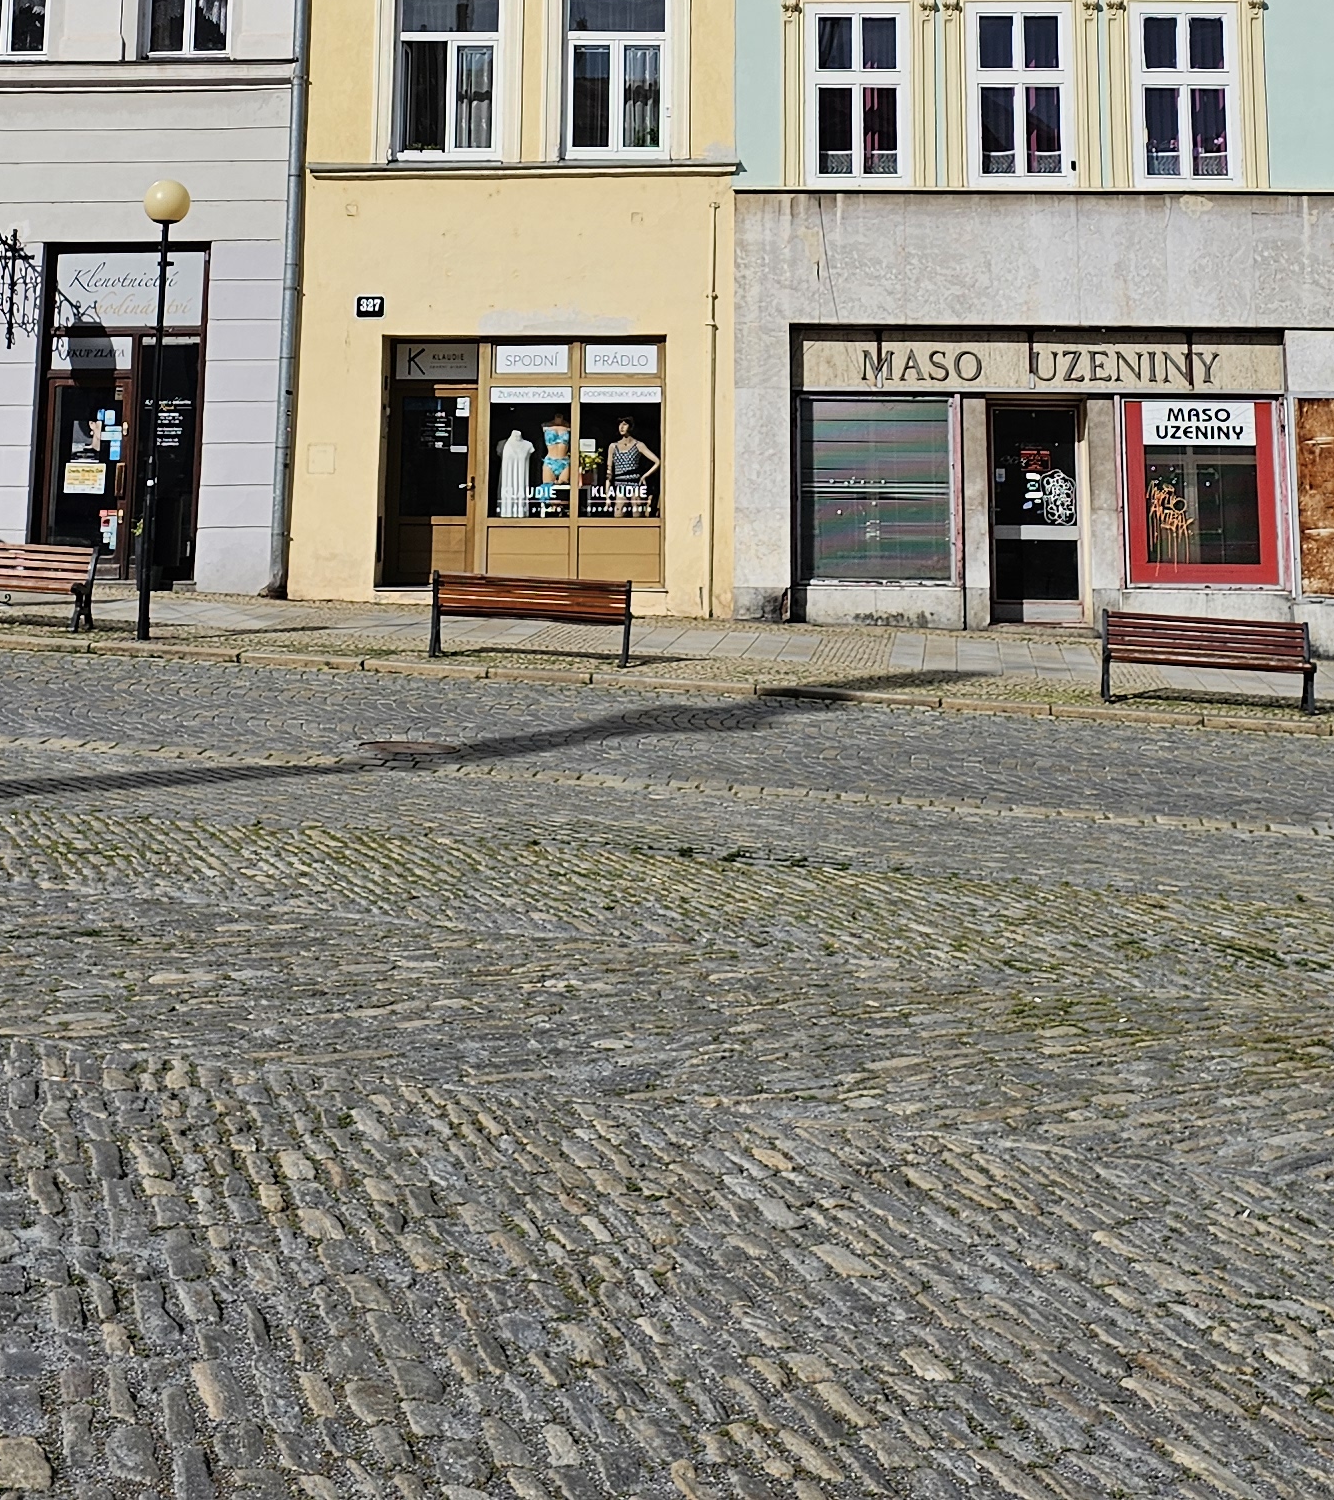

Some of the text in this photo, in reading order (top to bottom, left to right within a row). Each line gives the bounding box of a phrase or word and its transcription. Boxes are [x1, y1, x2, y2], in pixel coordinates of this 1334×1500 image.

[69, 262, 179, 293] Klenotnictí
[96, 290, 193, 316] hodinátví
[359, 299, 381, 312] 327
[407, 348, 425, 375] K
[505, 352, 649, 367] SPODNÍ PRÁDLO
[861, 348, 1220, 384] MASO UZENINY
[532, 390, 565, 399] PYŽAMA
[1166, 408, 1231, 422] MASO
[1155, 425, 1245, 441] UZENINY
[591, 486, 648, 498] KLAUDIE
